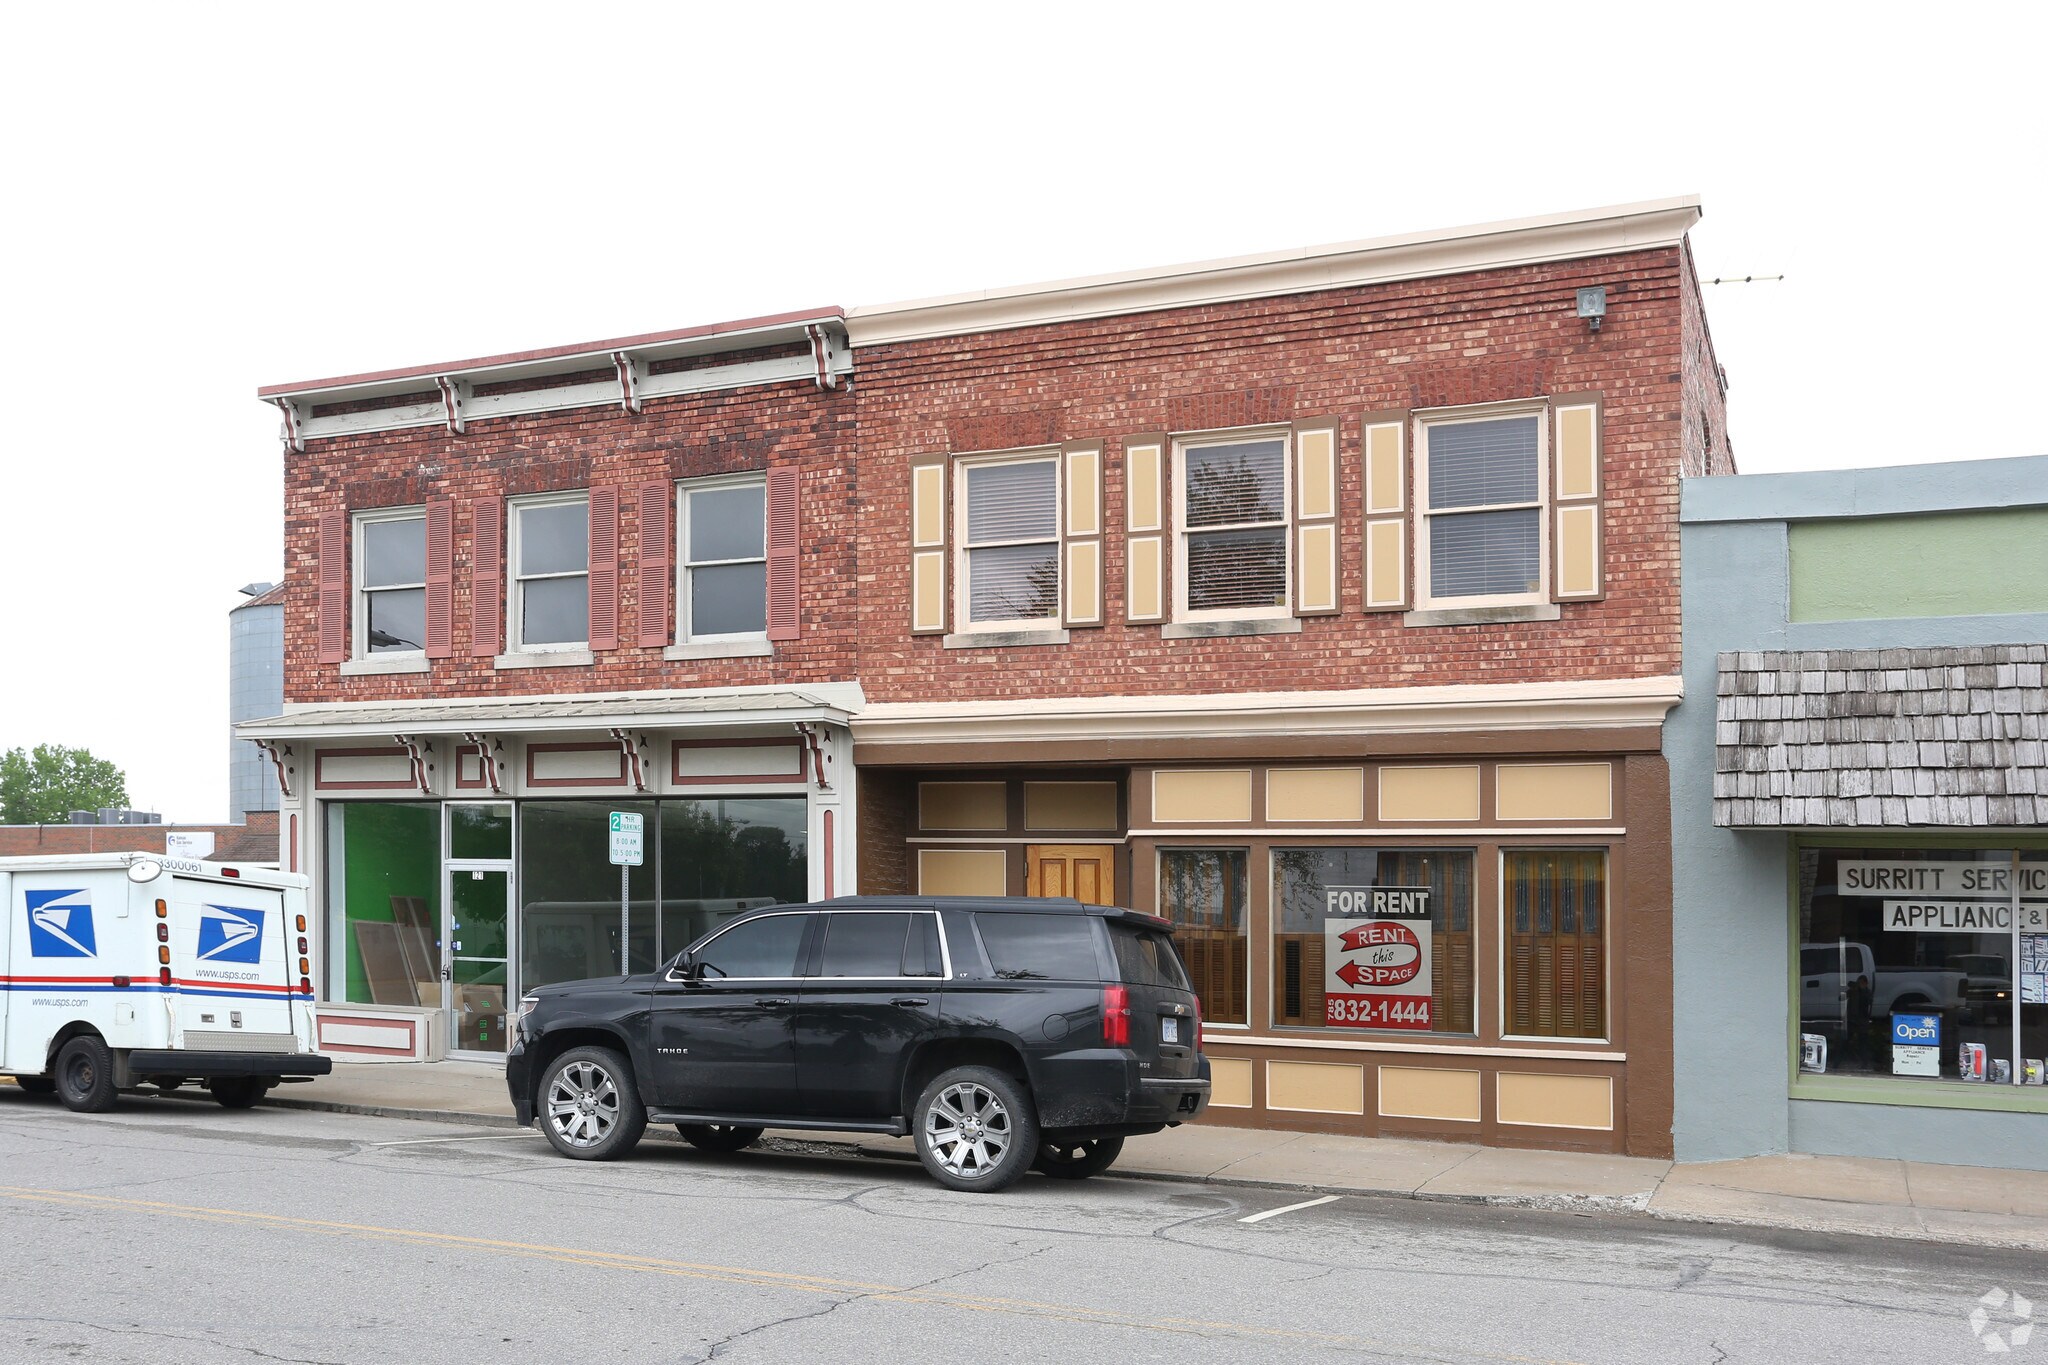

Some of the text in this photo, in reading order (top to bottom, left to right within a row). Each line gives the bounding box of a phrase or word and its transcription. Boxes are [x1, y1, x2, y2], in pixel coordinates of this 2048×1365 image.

[612, 816, 620, 829] 2
[1846, 868, 2048, 891] SURRITT SERVIC
[1327, 891, 1429, 914] FOR RENT
[2029, 910, 2042, 925] &
[1358, 928, 1406, 946] RENT
[1372, 949, 1394, 965] this
[195, 969, 260, 981] www.usps.com
[1357, 966, 1413, 983] SPACE
[32, 998, 89, 1008] www.usps.com
[1327, 999, 1430, 1024] 785 832-1444
[1896, 1023, 1936, 1040] Open
